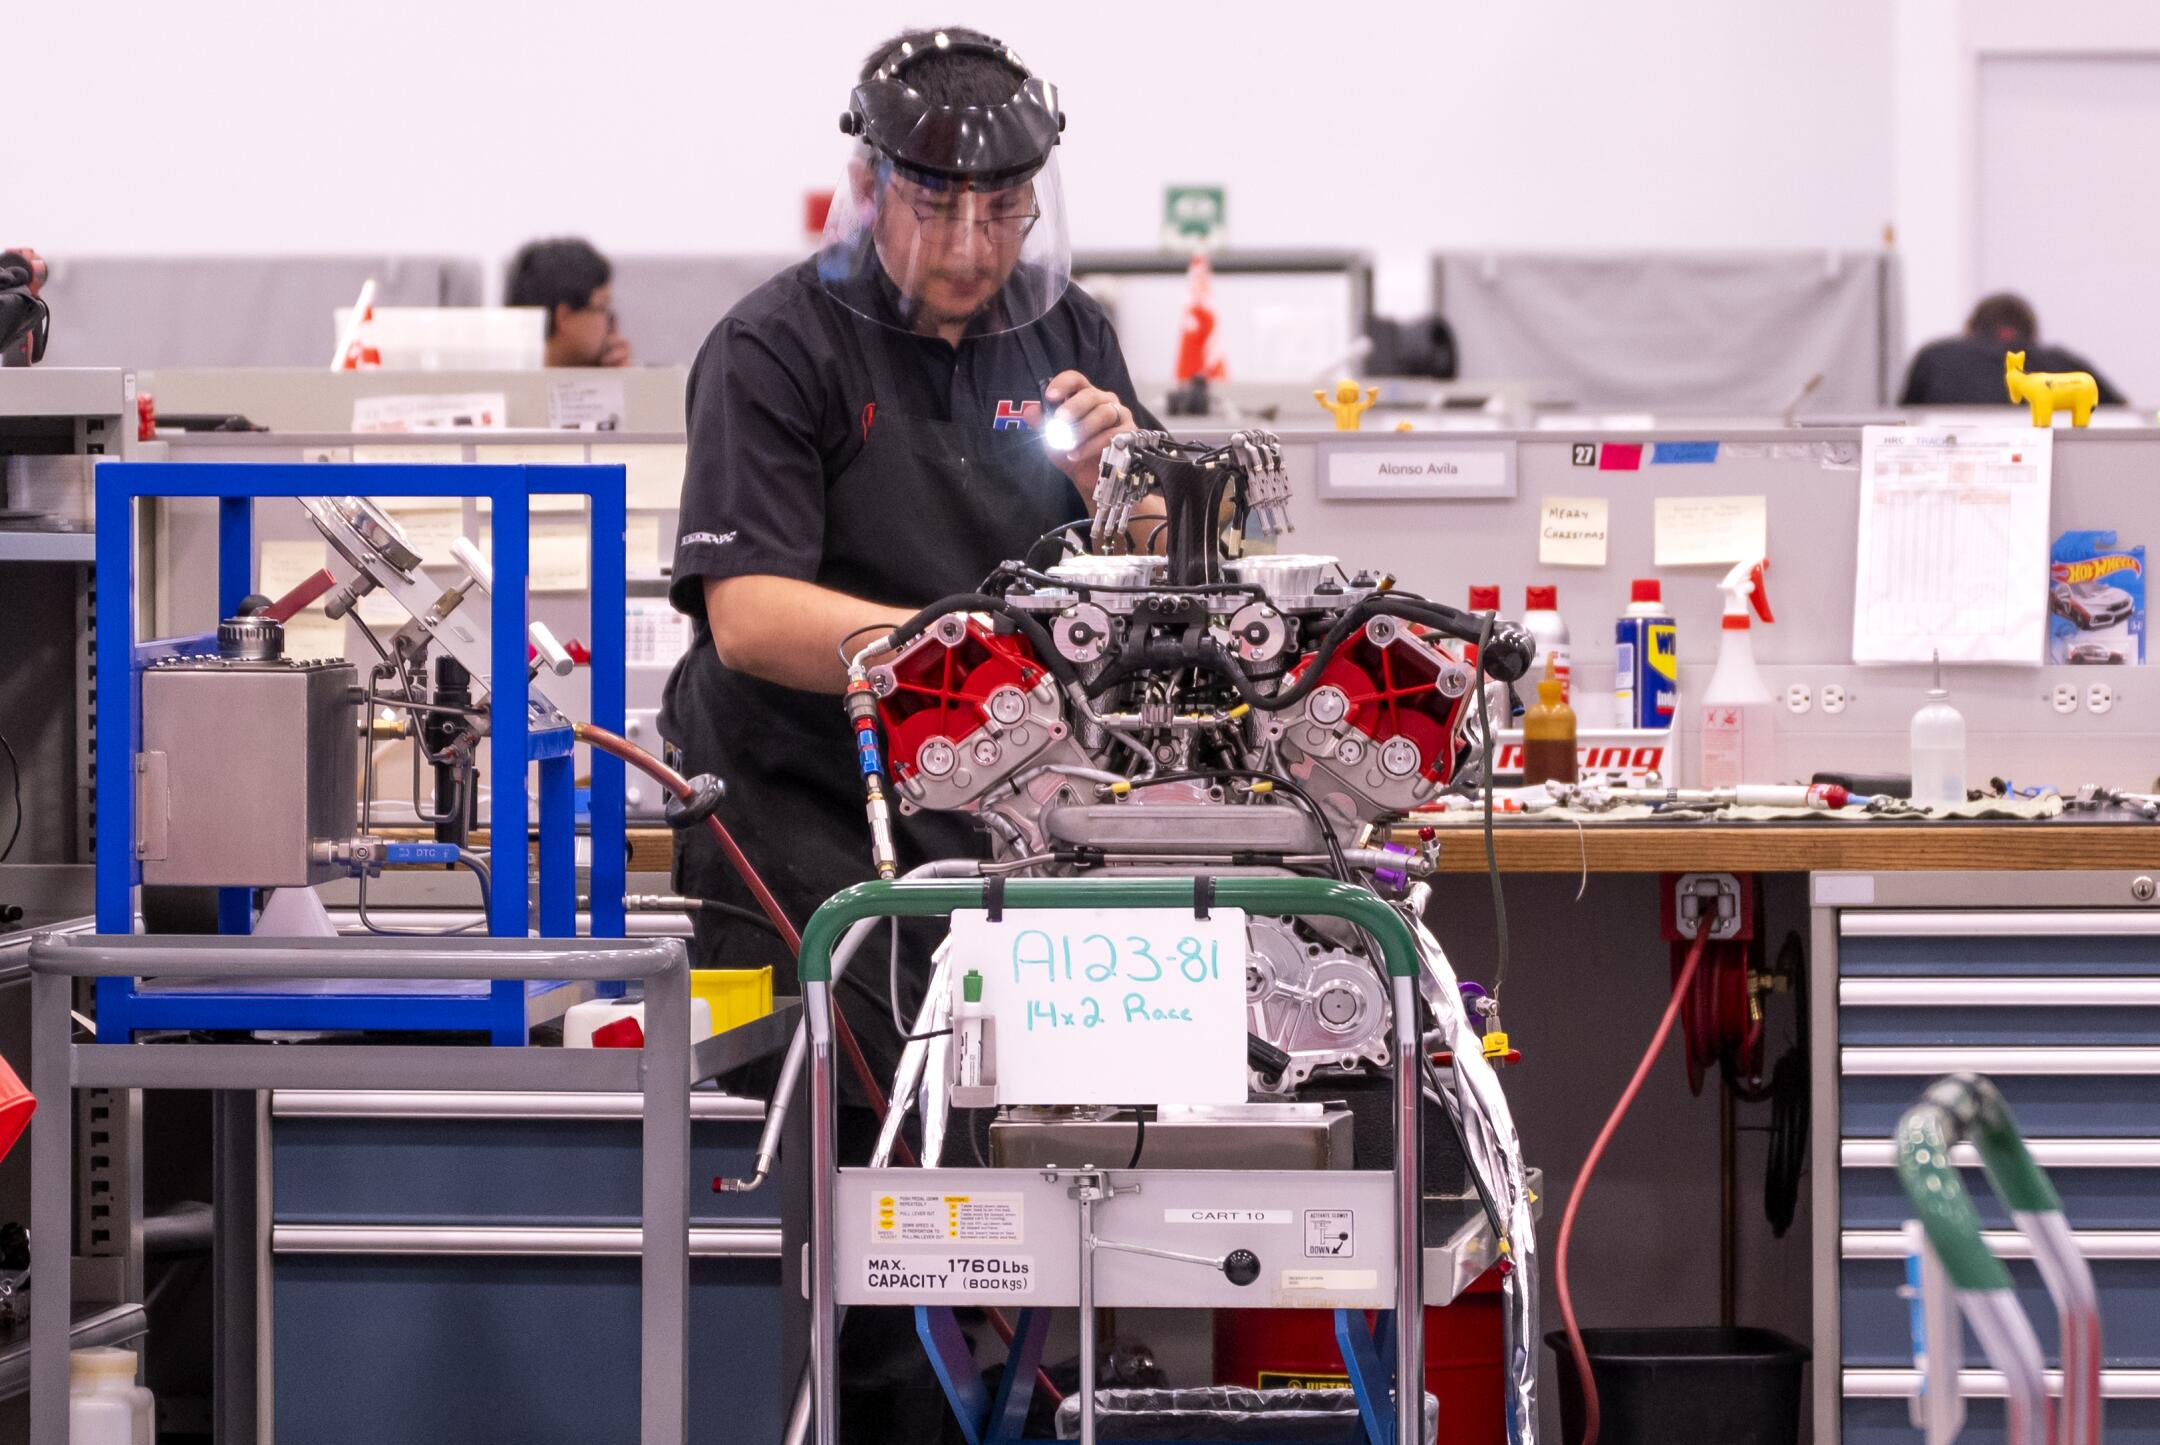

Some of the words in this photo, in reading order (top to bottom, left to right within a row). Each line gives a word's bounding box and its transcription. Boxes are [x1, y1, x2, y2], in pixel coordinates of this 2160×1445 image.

[1575, 446, 1593, 464] 27
[1379, 463, 1423, 475] Alonso
[1427, 463, 1458, 475] Avila
[2067, 562, 2095, 585] HOT
[2095, 556, 2137, 580] WHEELS
[1497, 743, 1664, 776] Ring
[1013, 930, 1218, 984] A123-81
[1122, 992, 1193, 1023] Race
[1191, 1212, 1240, 1221] CART
[1247, 1212, 1265, 1221] 10
[1310, 1245, 1330, 1254] DOWN
[868, 1259, 906, 1270] MAX.
[868, 1274, 948, 1288] CAPACITY
